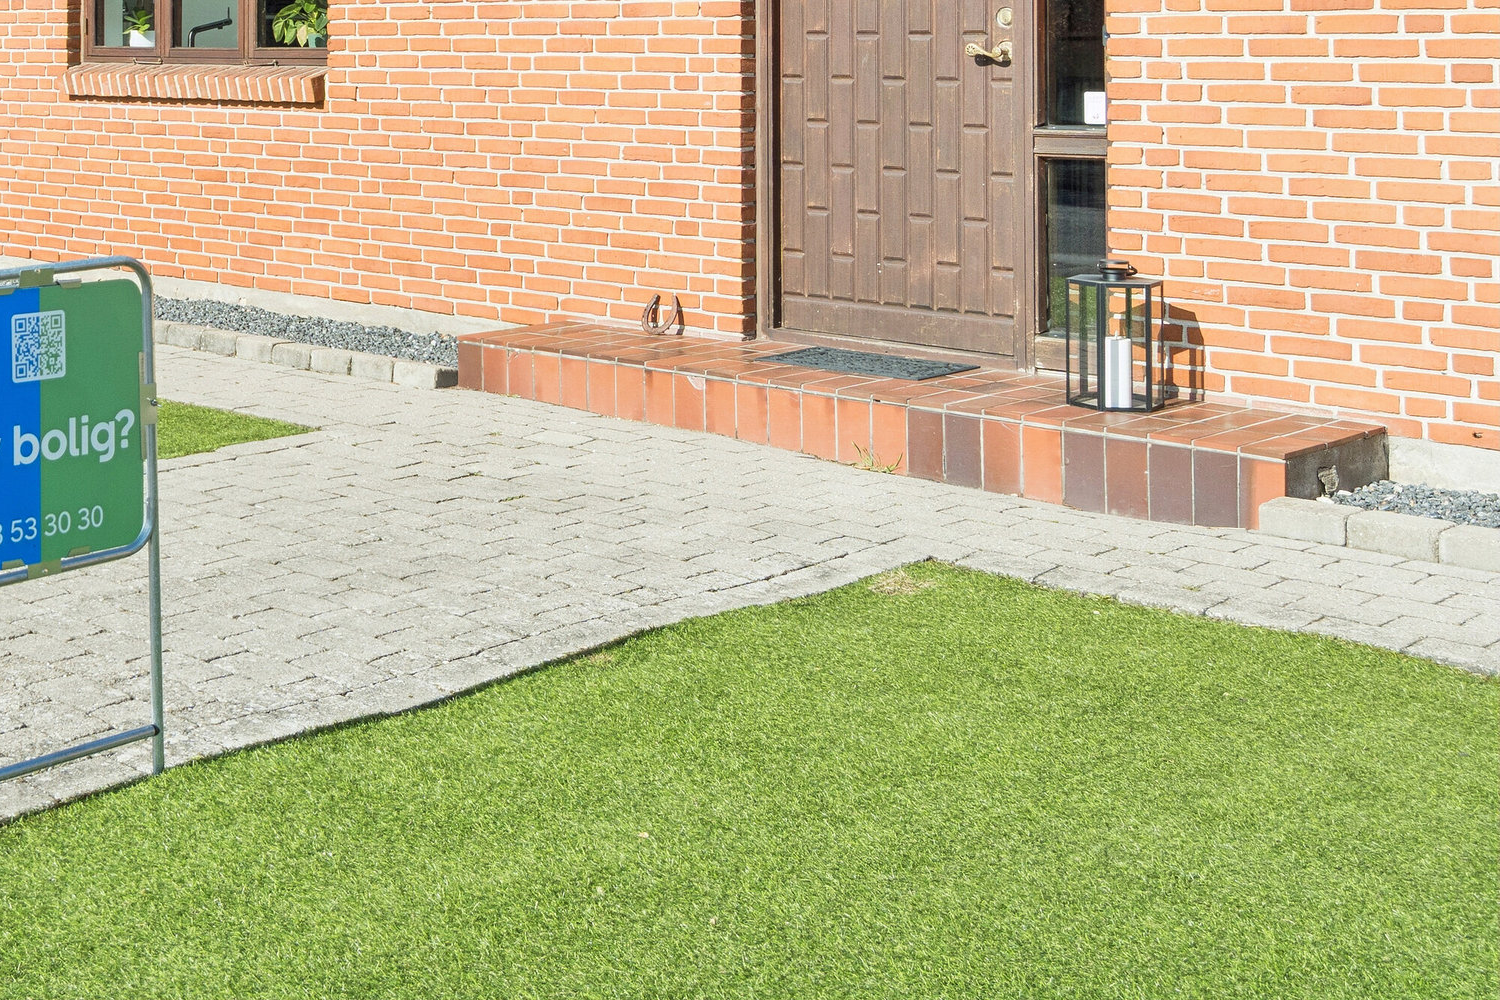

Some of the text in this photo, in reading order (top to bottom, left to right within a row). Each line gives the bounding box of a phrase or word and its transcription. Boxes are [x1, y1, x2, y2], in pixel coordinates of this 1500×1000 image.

[13, 408, 135, 466] bolig?
[10, 516, 38, 543] 53
[44, 511, 71, 537] 30
[77, 505, 104, 530] 30
